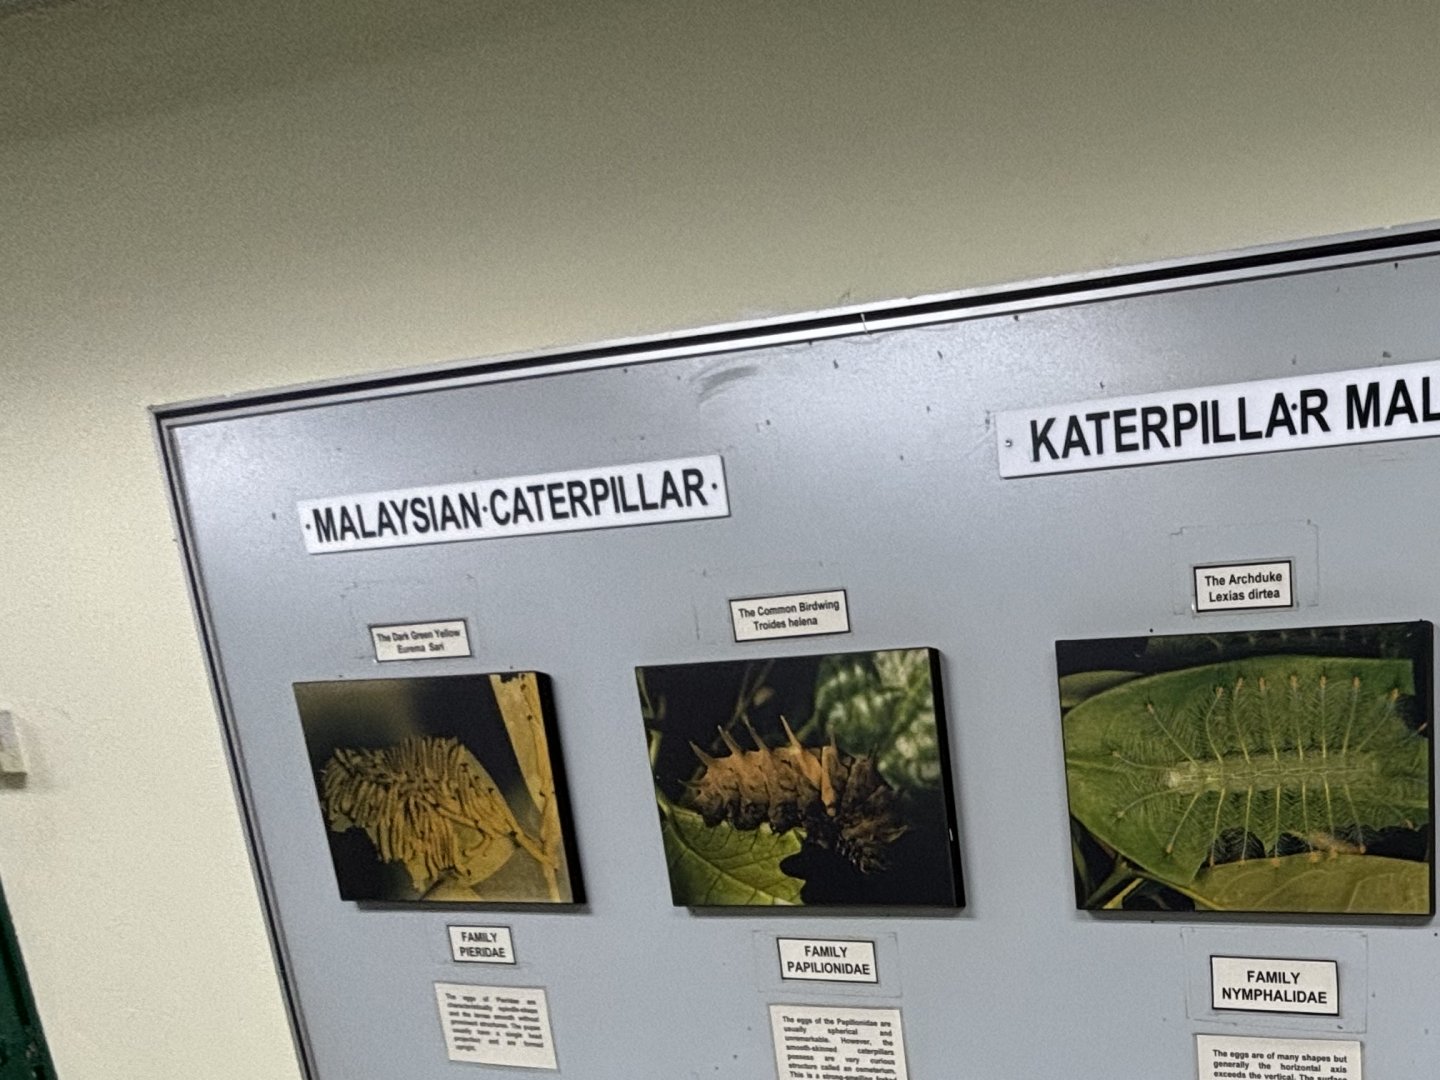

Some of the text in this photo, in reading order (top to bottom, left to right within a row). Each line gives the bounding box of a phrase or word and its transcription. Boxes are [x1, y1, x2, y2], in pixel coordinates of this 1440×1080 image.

[1030, 388, 1331, 462] KATERPILLAR
[312, 467, 709, 543] MALAYSIAN CATERPILLAR
[1204, 571, 1282, 586] The Archduke
[1209, 588, 1280, 602] Lexias dirtea
[738, 600, 840, 618] The Common Birdwing
[753, 617, 818, 631] Troides helena
[377, 633, 391, 642] The
[392, 632, 409, 641] Dark
[461, 932, 497, 942] FAMILY
[460, 947, 506, 957] PIERIDAE
[804, 945, 847, 958] FAMILY
[787, 961, 870, 975] PAPILIONIDAE
[1247, 970, 1300, 984] FAMILY
[1222, 987, 1327, 1004] NYMPHALIDAE
[1212, 1048, 1227, 1057] The
[1229, 1051, 1249, 1059] eggs
[1266, 1051, 1274, 1059] of
[1276, 1054, 1299, 1062] many
[1301, 1053, 1330, 1062] shapes
[1333, 1054, 1347, 1062] but
[1213, 1060, 1347, 1073] generally the horizontal axis
